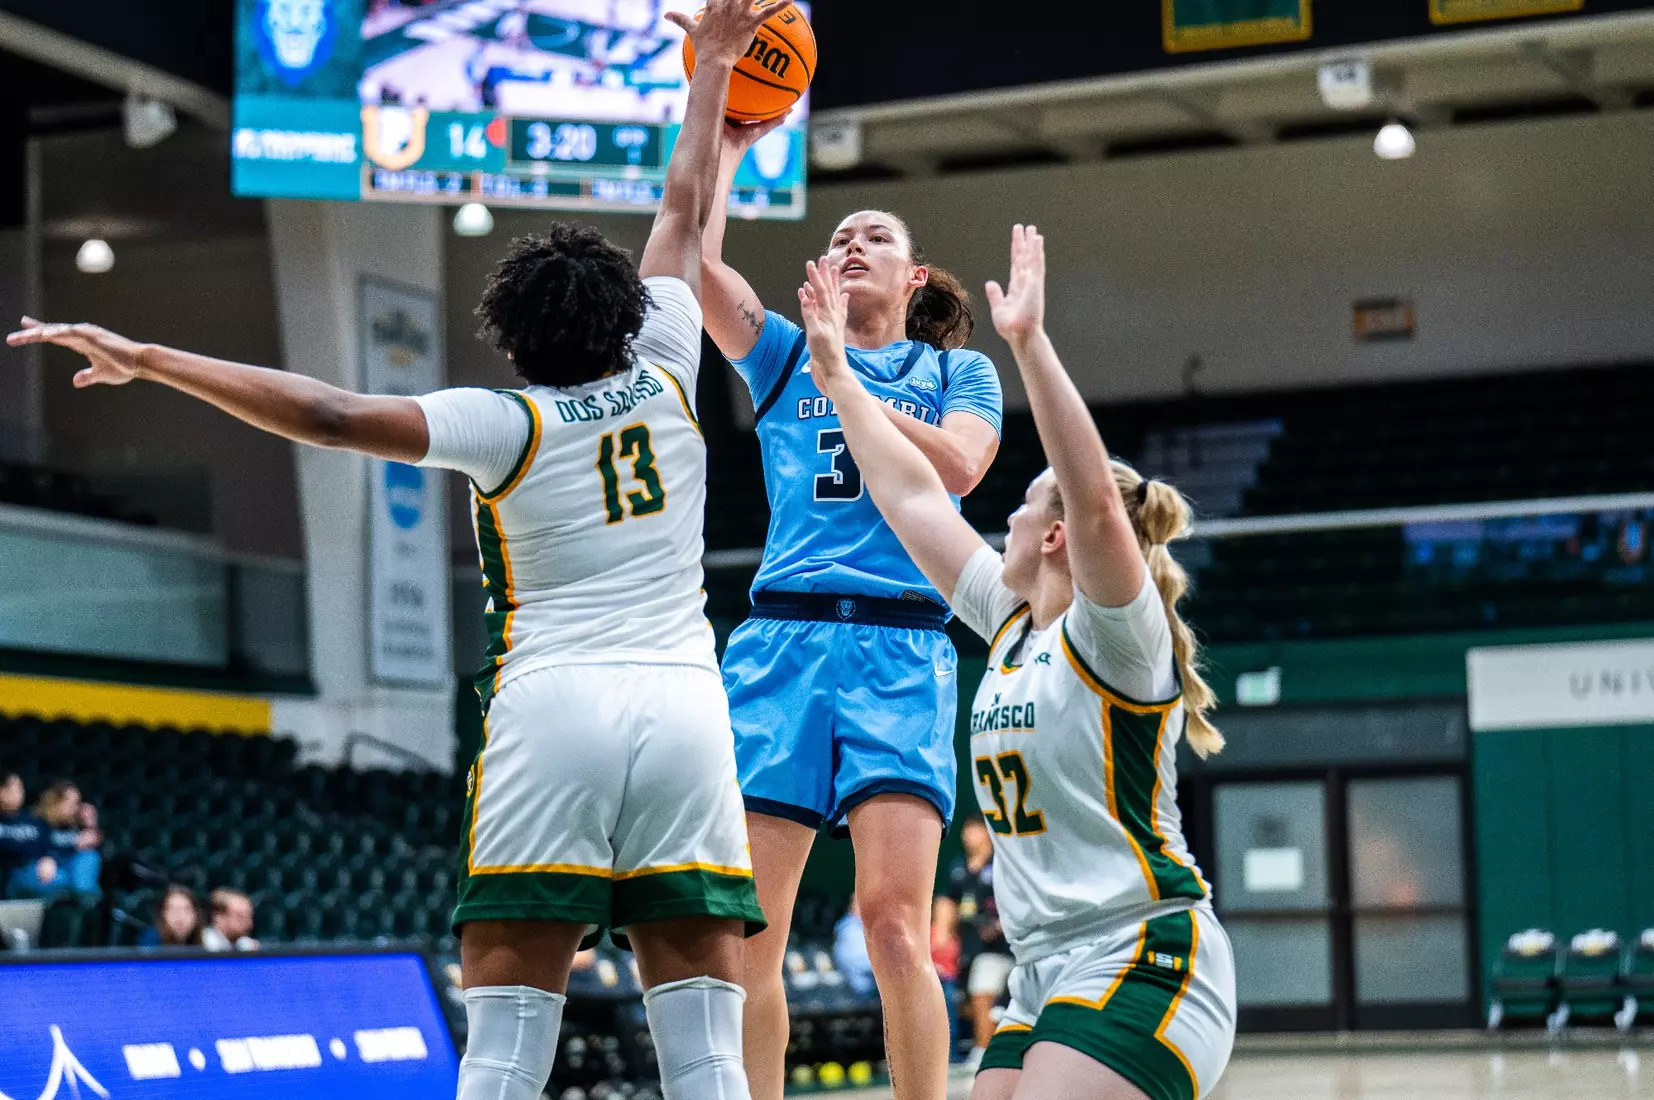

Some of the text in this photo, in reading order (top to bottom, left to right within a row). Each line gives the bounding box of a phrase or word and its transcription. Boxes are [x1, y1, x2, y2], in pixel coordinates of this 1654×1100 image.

[554, 394, 604, 423] DOS
[594, 421, 667, 525] 13
[813, 427, 864, 502] 3
[974, 750, 1048, 836] 32
